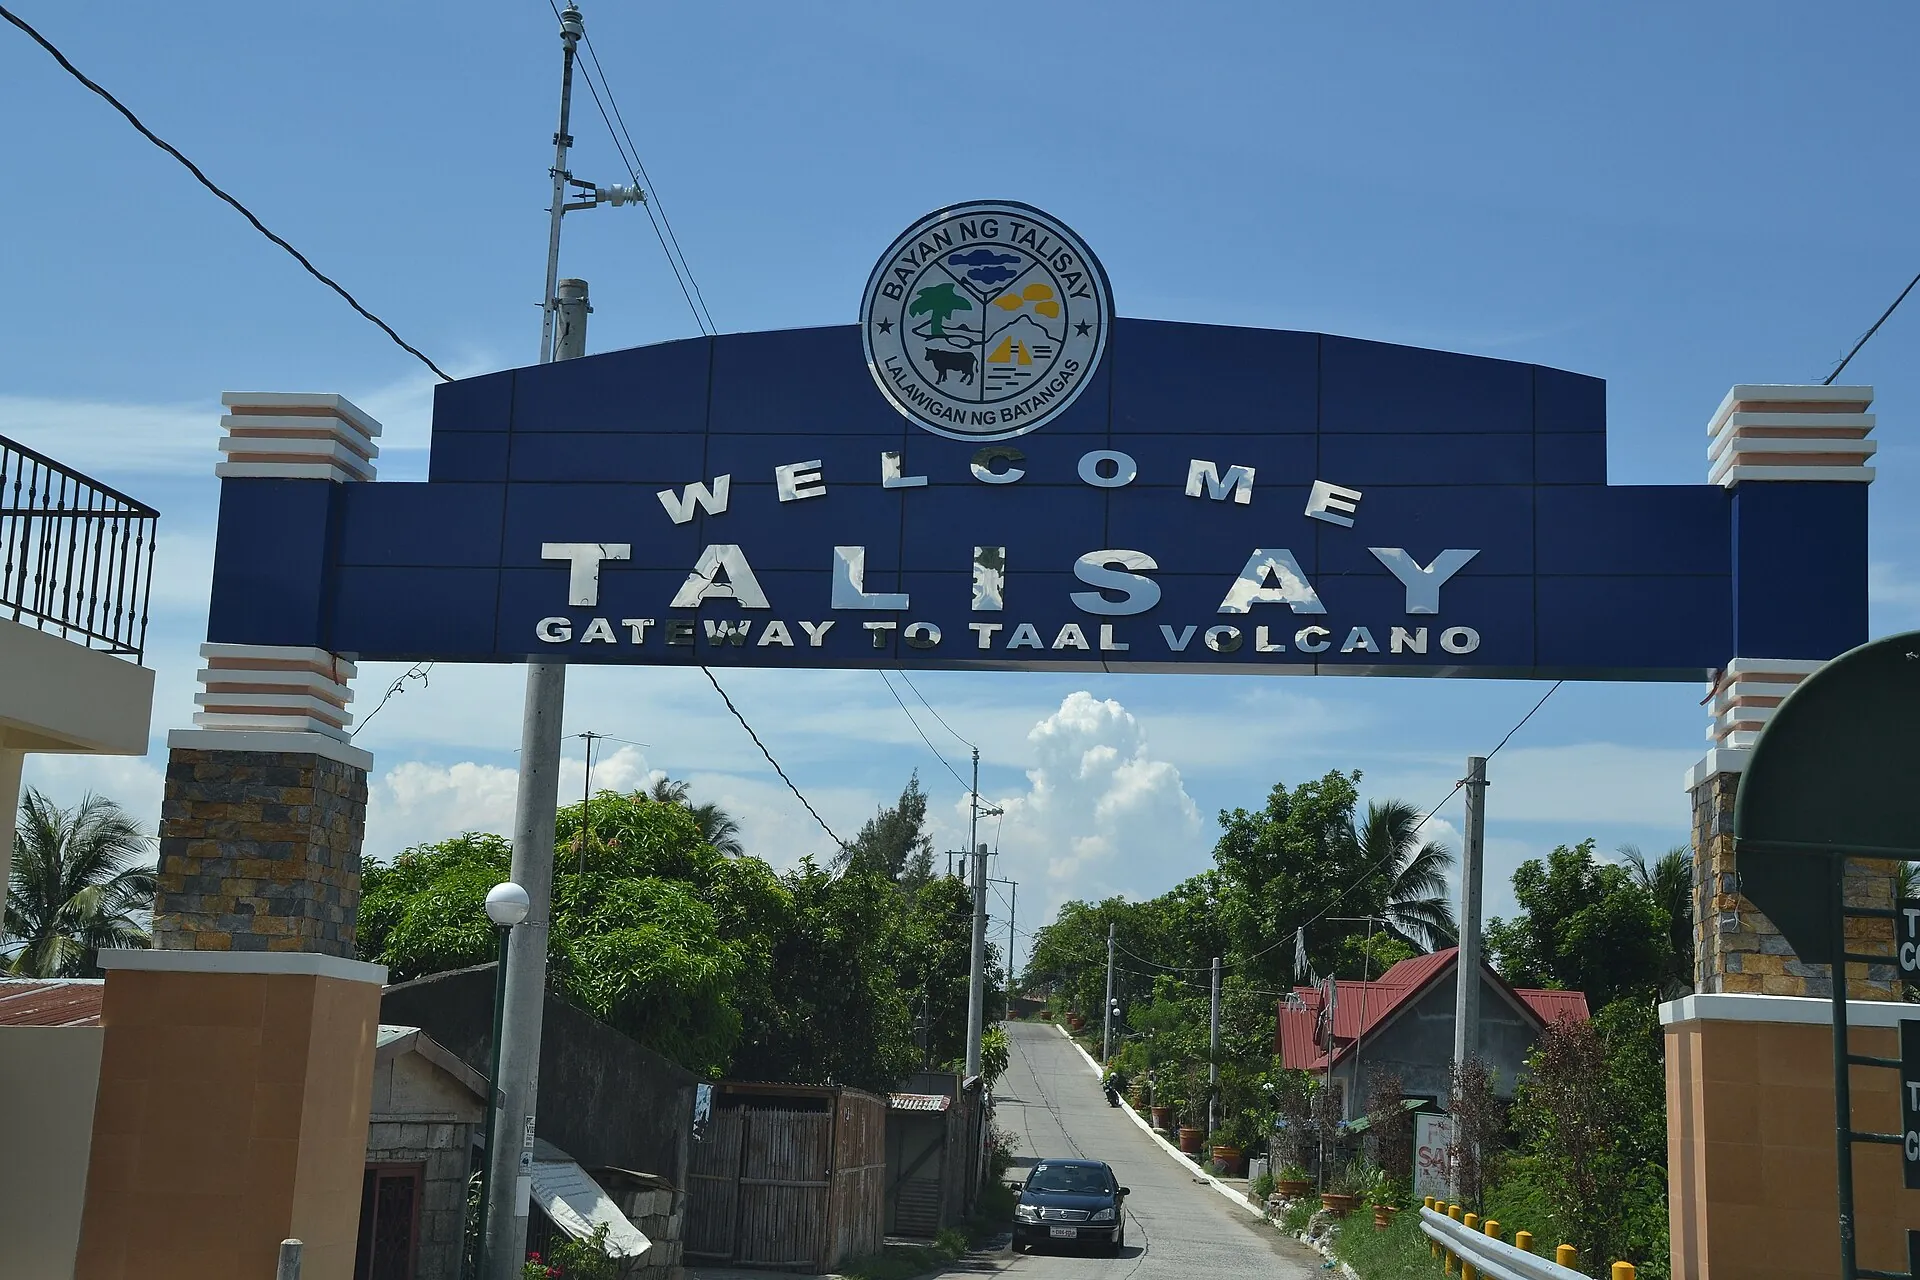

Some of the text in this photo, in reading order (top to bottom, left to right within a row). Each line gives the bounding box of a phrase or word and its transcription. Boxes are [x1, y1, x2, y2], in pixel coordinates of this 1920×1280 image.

[882, 218, 1092, 301] BAYAN NG TALISAY
[884, 355, 1080, 425] LALAWIGAN NG BATANGAS
[656, 446, 1363, 528] WELCOME
[540, 542, 1481, 616] TALISAY
[535, 616, 1481, 655] GATEWAY TO TAAL VOLCANO
